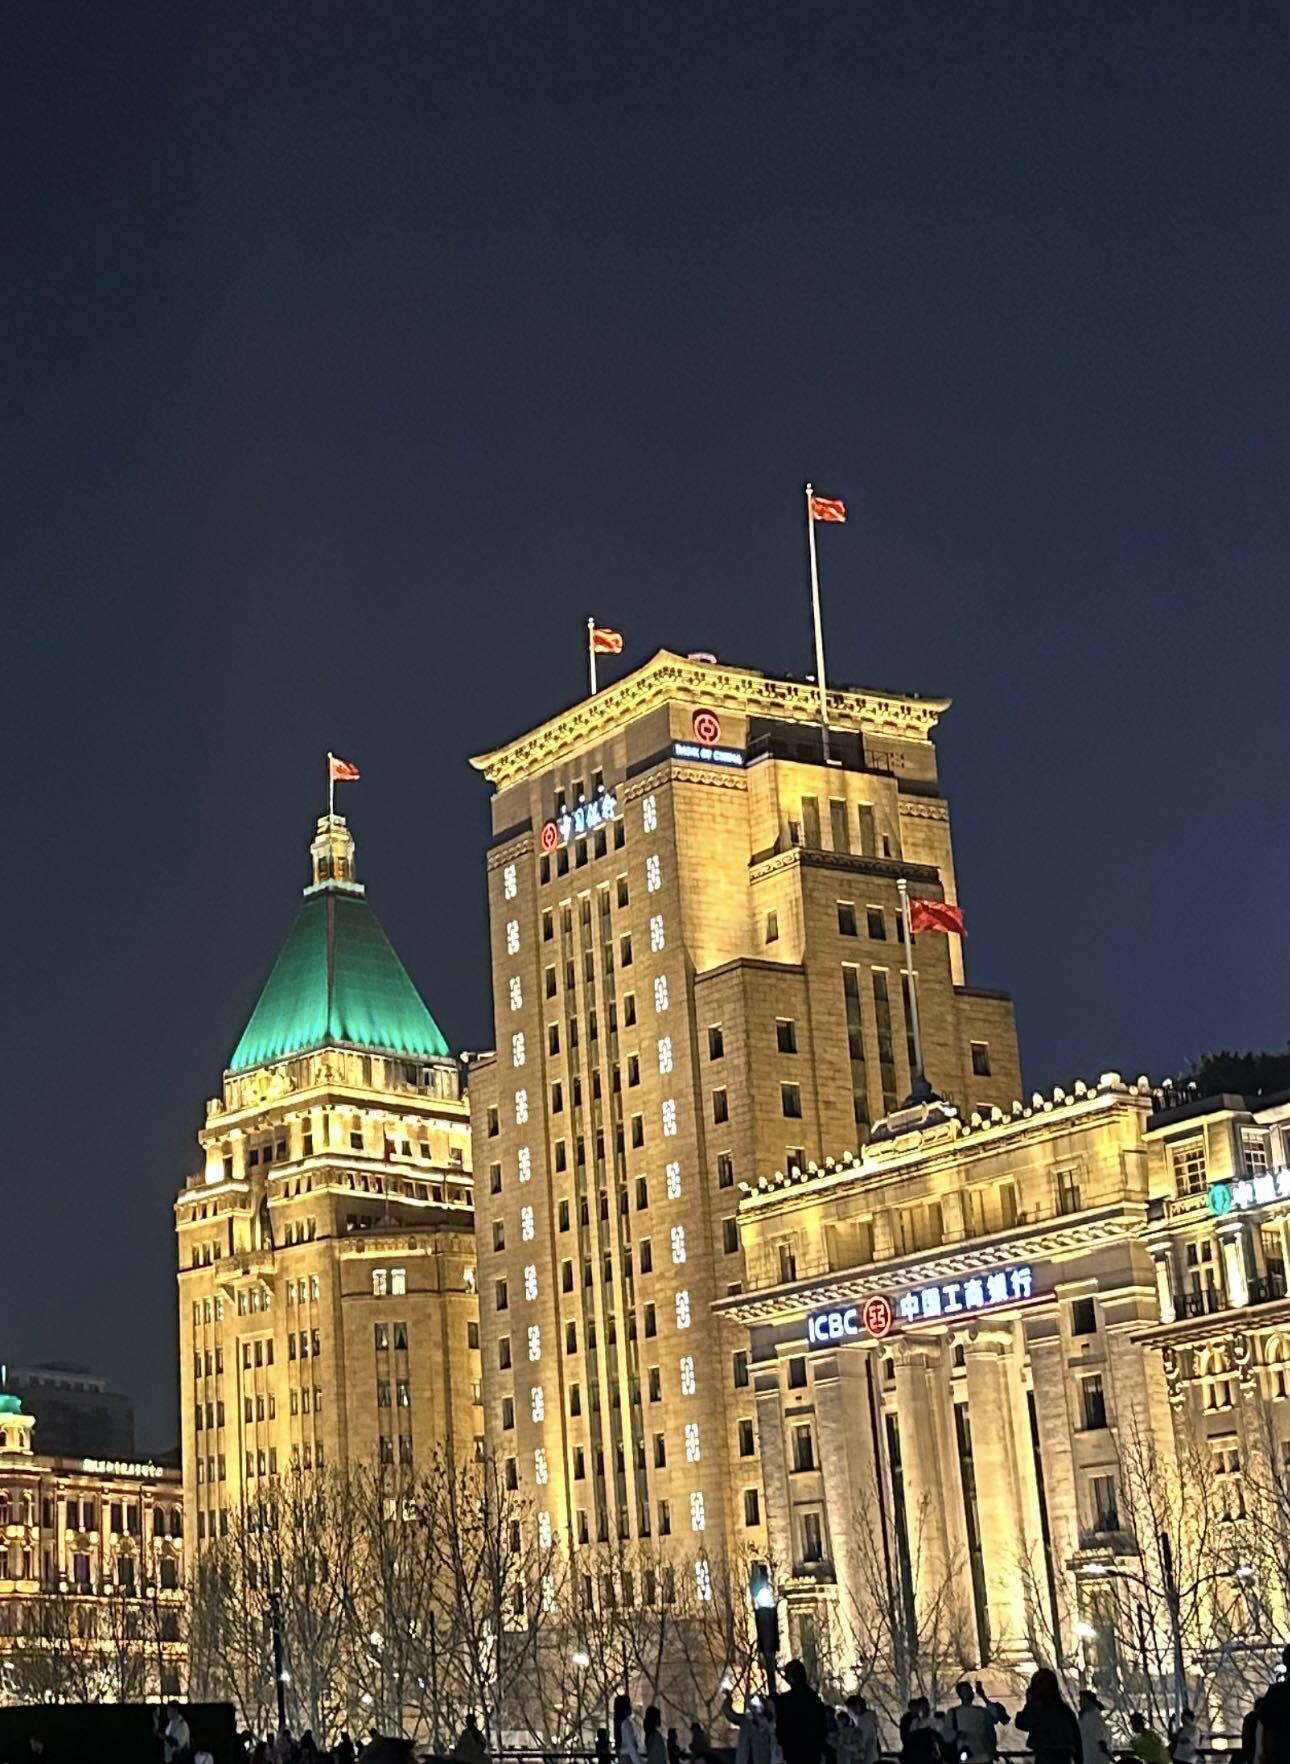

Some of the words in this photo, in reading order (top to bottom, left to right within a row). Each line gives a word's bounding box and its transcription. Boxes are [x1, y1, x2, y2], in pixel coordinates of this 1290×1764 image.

[901, 1267, 1032, 1321] 中国工商银行
[808, 1308, 858, 1342] ICBC
